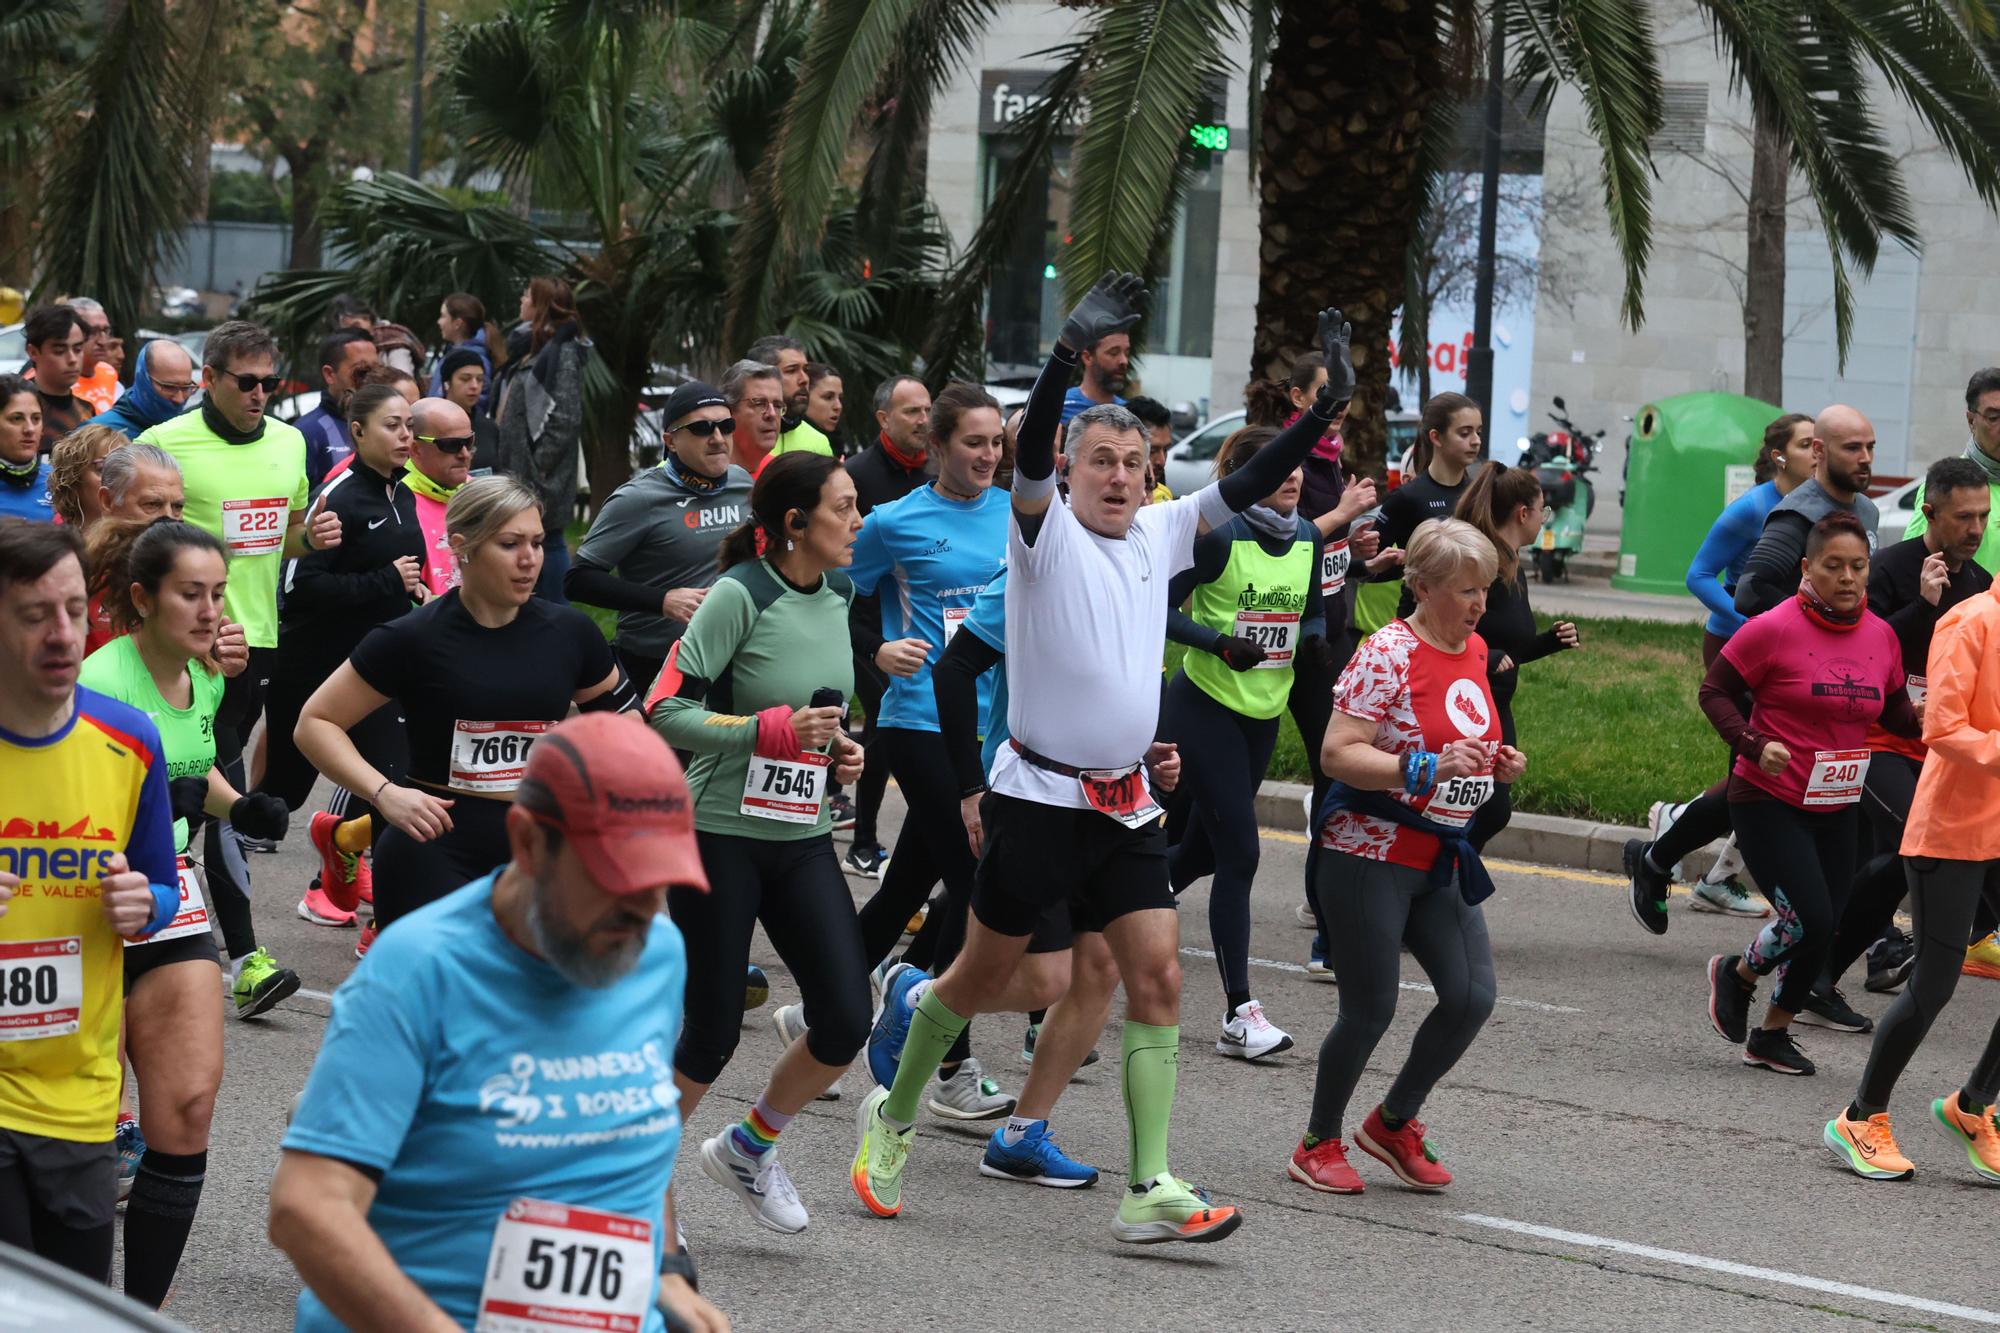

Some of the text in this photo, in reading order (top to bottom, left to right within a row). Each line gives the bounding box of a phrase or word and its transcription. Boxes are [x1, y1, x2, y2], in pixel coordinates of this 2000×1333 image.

[239, 511, 278, 532] 222
[1245, 626, 1288, 648] 5278
[471, 735, 535, 765] 7667
[761, 764, 815, 799] 7545
[1823, 764, 1859, 782] 240
[523, 1237, 623, 1301] 5176
